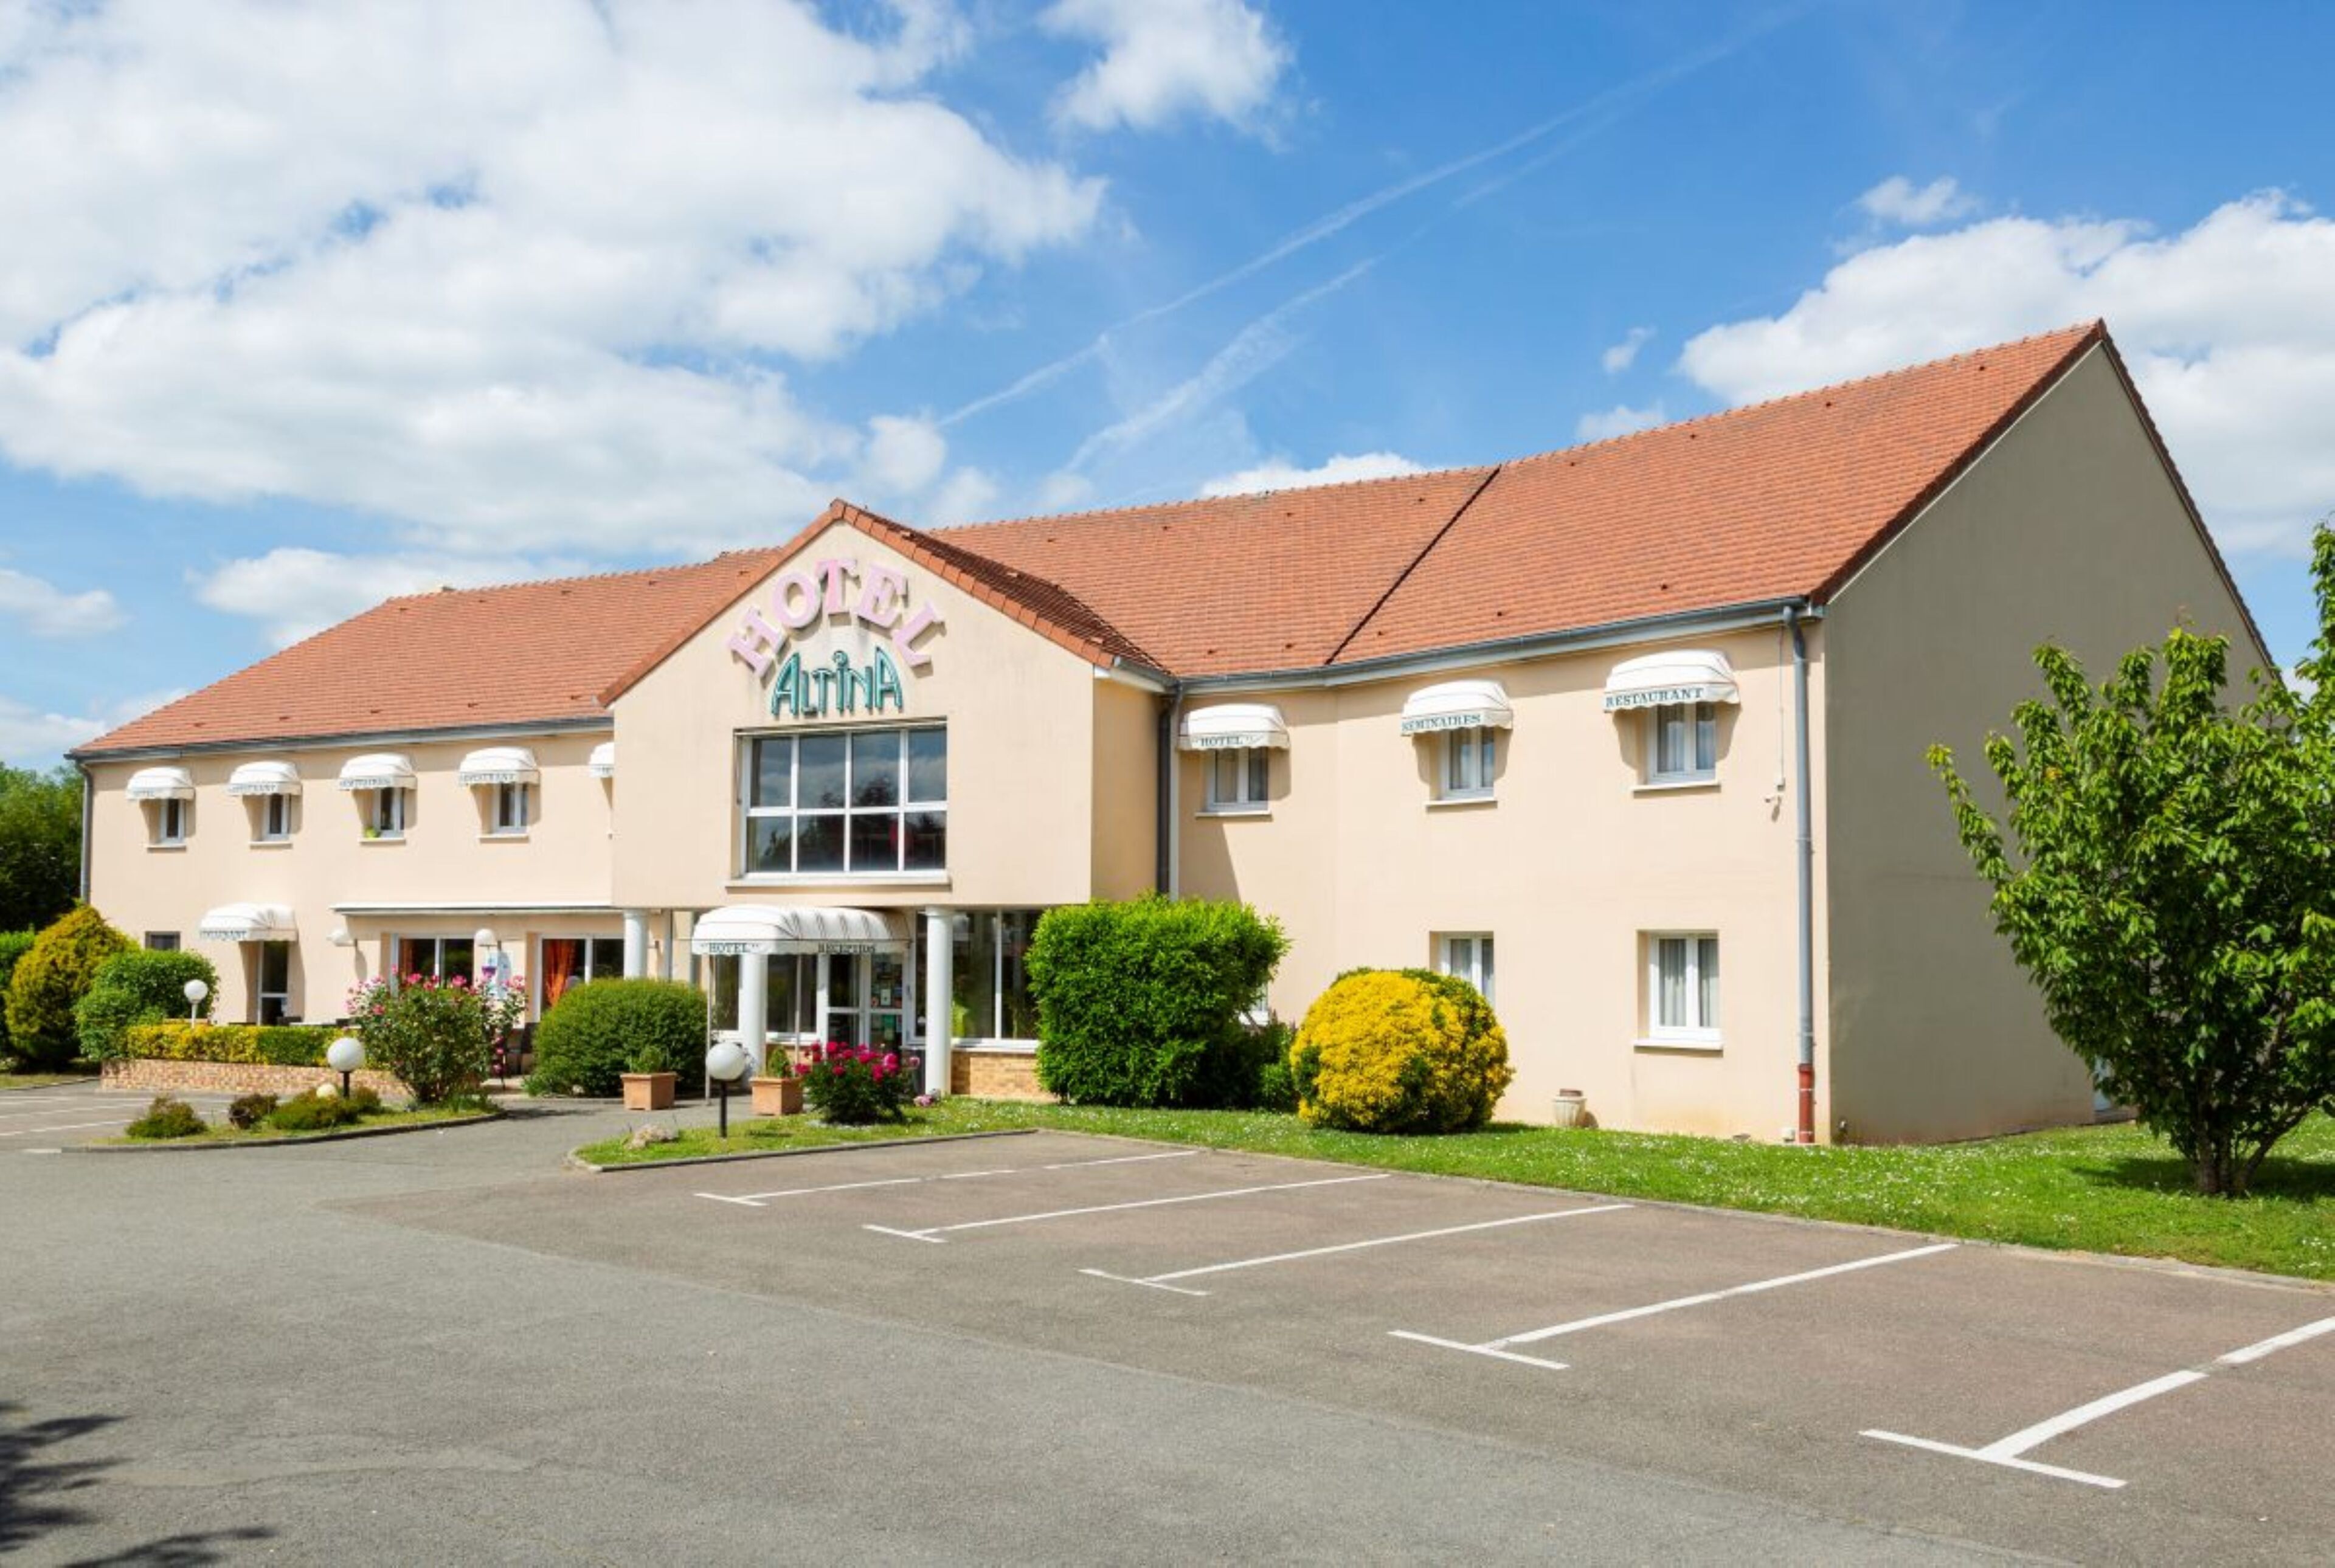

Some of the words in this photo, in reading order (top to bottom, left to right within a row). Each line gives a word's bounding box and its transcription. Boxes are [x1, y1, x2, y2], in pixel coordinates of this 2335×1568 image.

[728, 559, 946, 677] HOTEL
[771, 646, 904, 717] ALTINA
[1606, 687, 1704, 708] RESTAURANT
[1200, 736, 1244, 747] HOTEL
[708, 942, 750, 953] HOTEL
